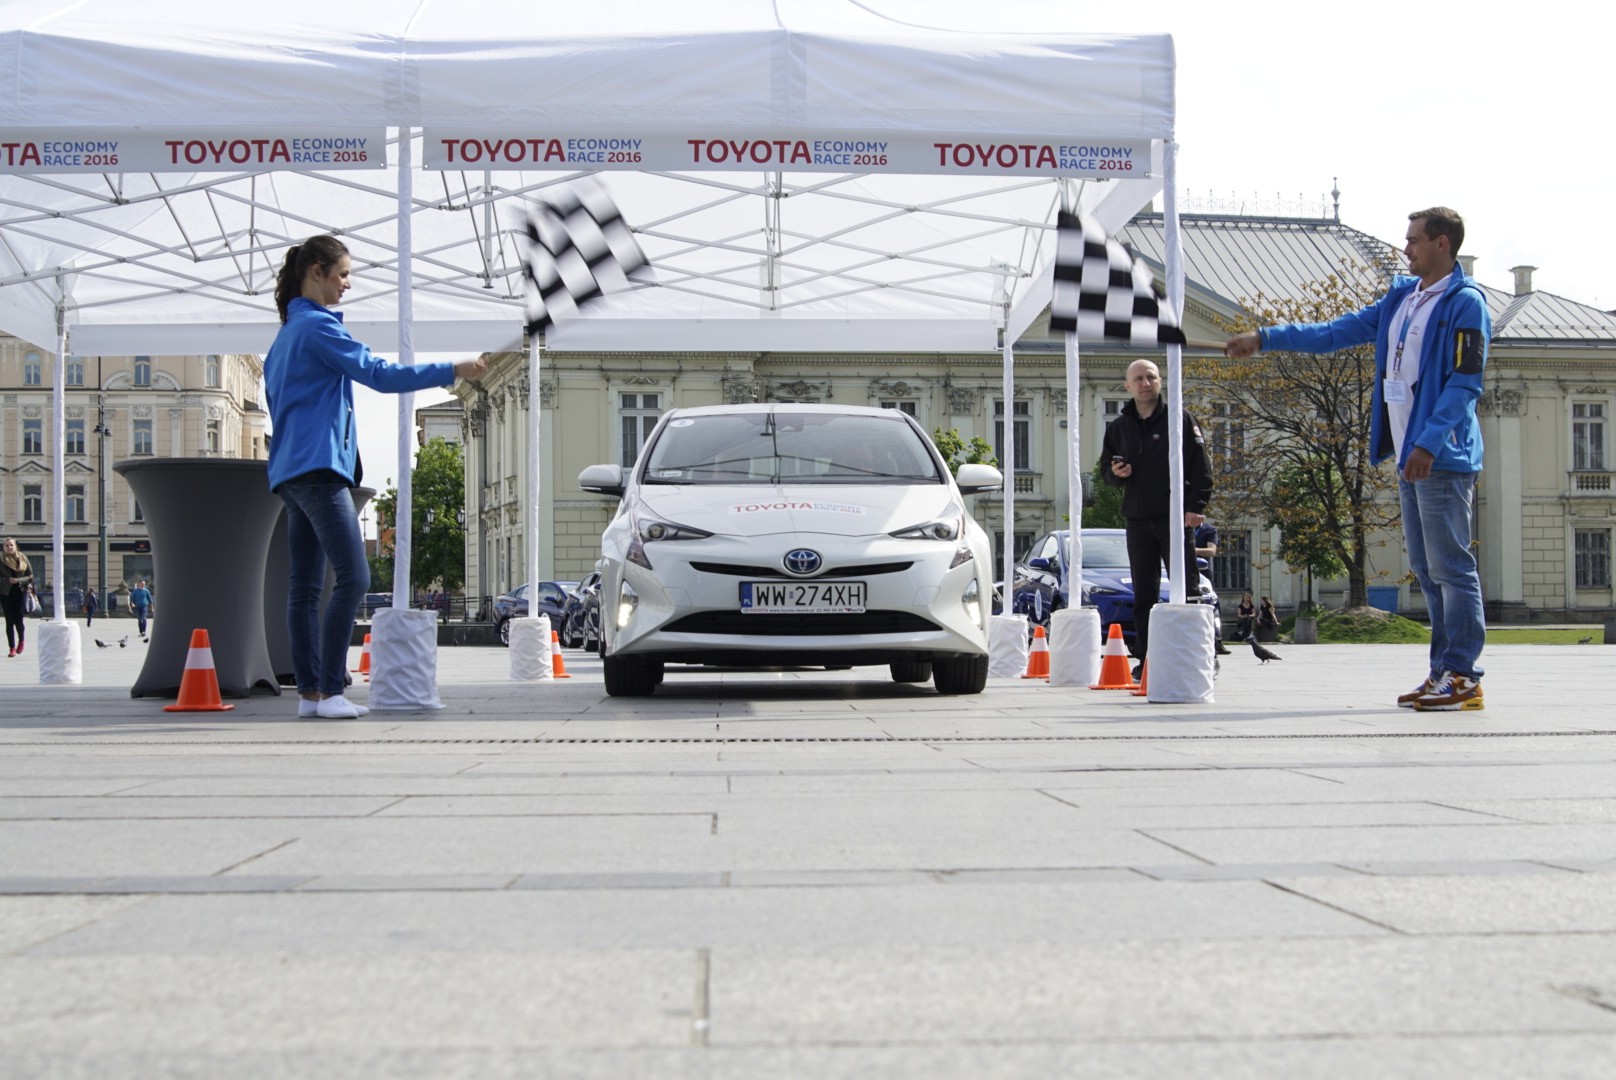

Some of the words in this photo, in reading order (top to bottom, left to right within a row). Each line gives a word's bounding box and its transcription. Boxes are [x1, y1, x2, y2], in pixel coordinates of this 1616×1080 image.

[44, 142, 118, 153] ECONOMY
[293, 139, 367, 149] ECONOMY
[568, 139, 642, 150] ECONOMY
[814, 141, 888, 152] ECONOMY
[0, 142, 41, 166] TA
[165, 139, 291, 165] TOYOTA
[293, 151, 330, 163] RACE
[334, 151, 367, 162] 2016
[441, 139, 565, 163] TOYOTA
[568, 151, 605, 163] RACE
[608, 152, 641, 163] 2016
[688, 139, 812, 165] TOYOTA
[934, 143, 1057, 168] TOYOTA
[1060, 146, 1132, 157] ECONOMY
[44, 154, 81, 165] RACE
[84, 154, 118, 165] 2016
[814, 154, 850, 165] RACE
[854, 154, 887, 165] 2016
[1060, 158, 1096, 170] RACE
[1099, 160, 1132, 171] 2016
[734, 503, 813, 512] TOYOTA
[756, 585, 786, 606] WW
[795, 585, 860, 606] 274XH
